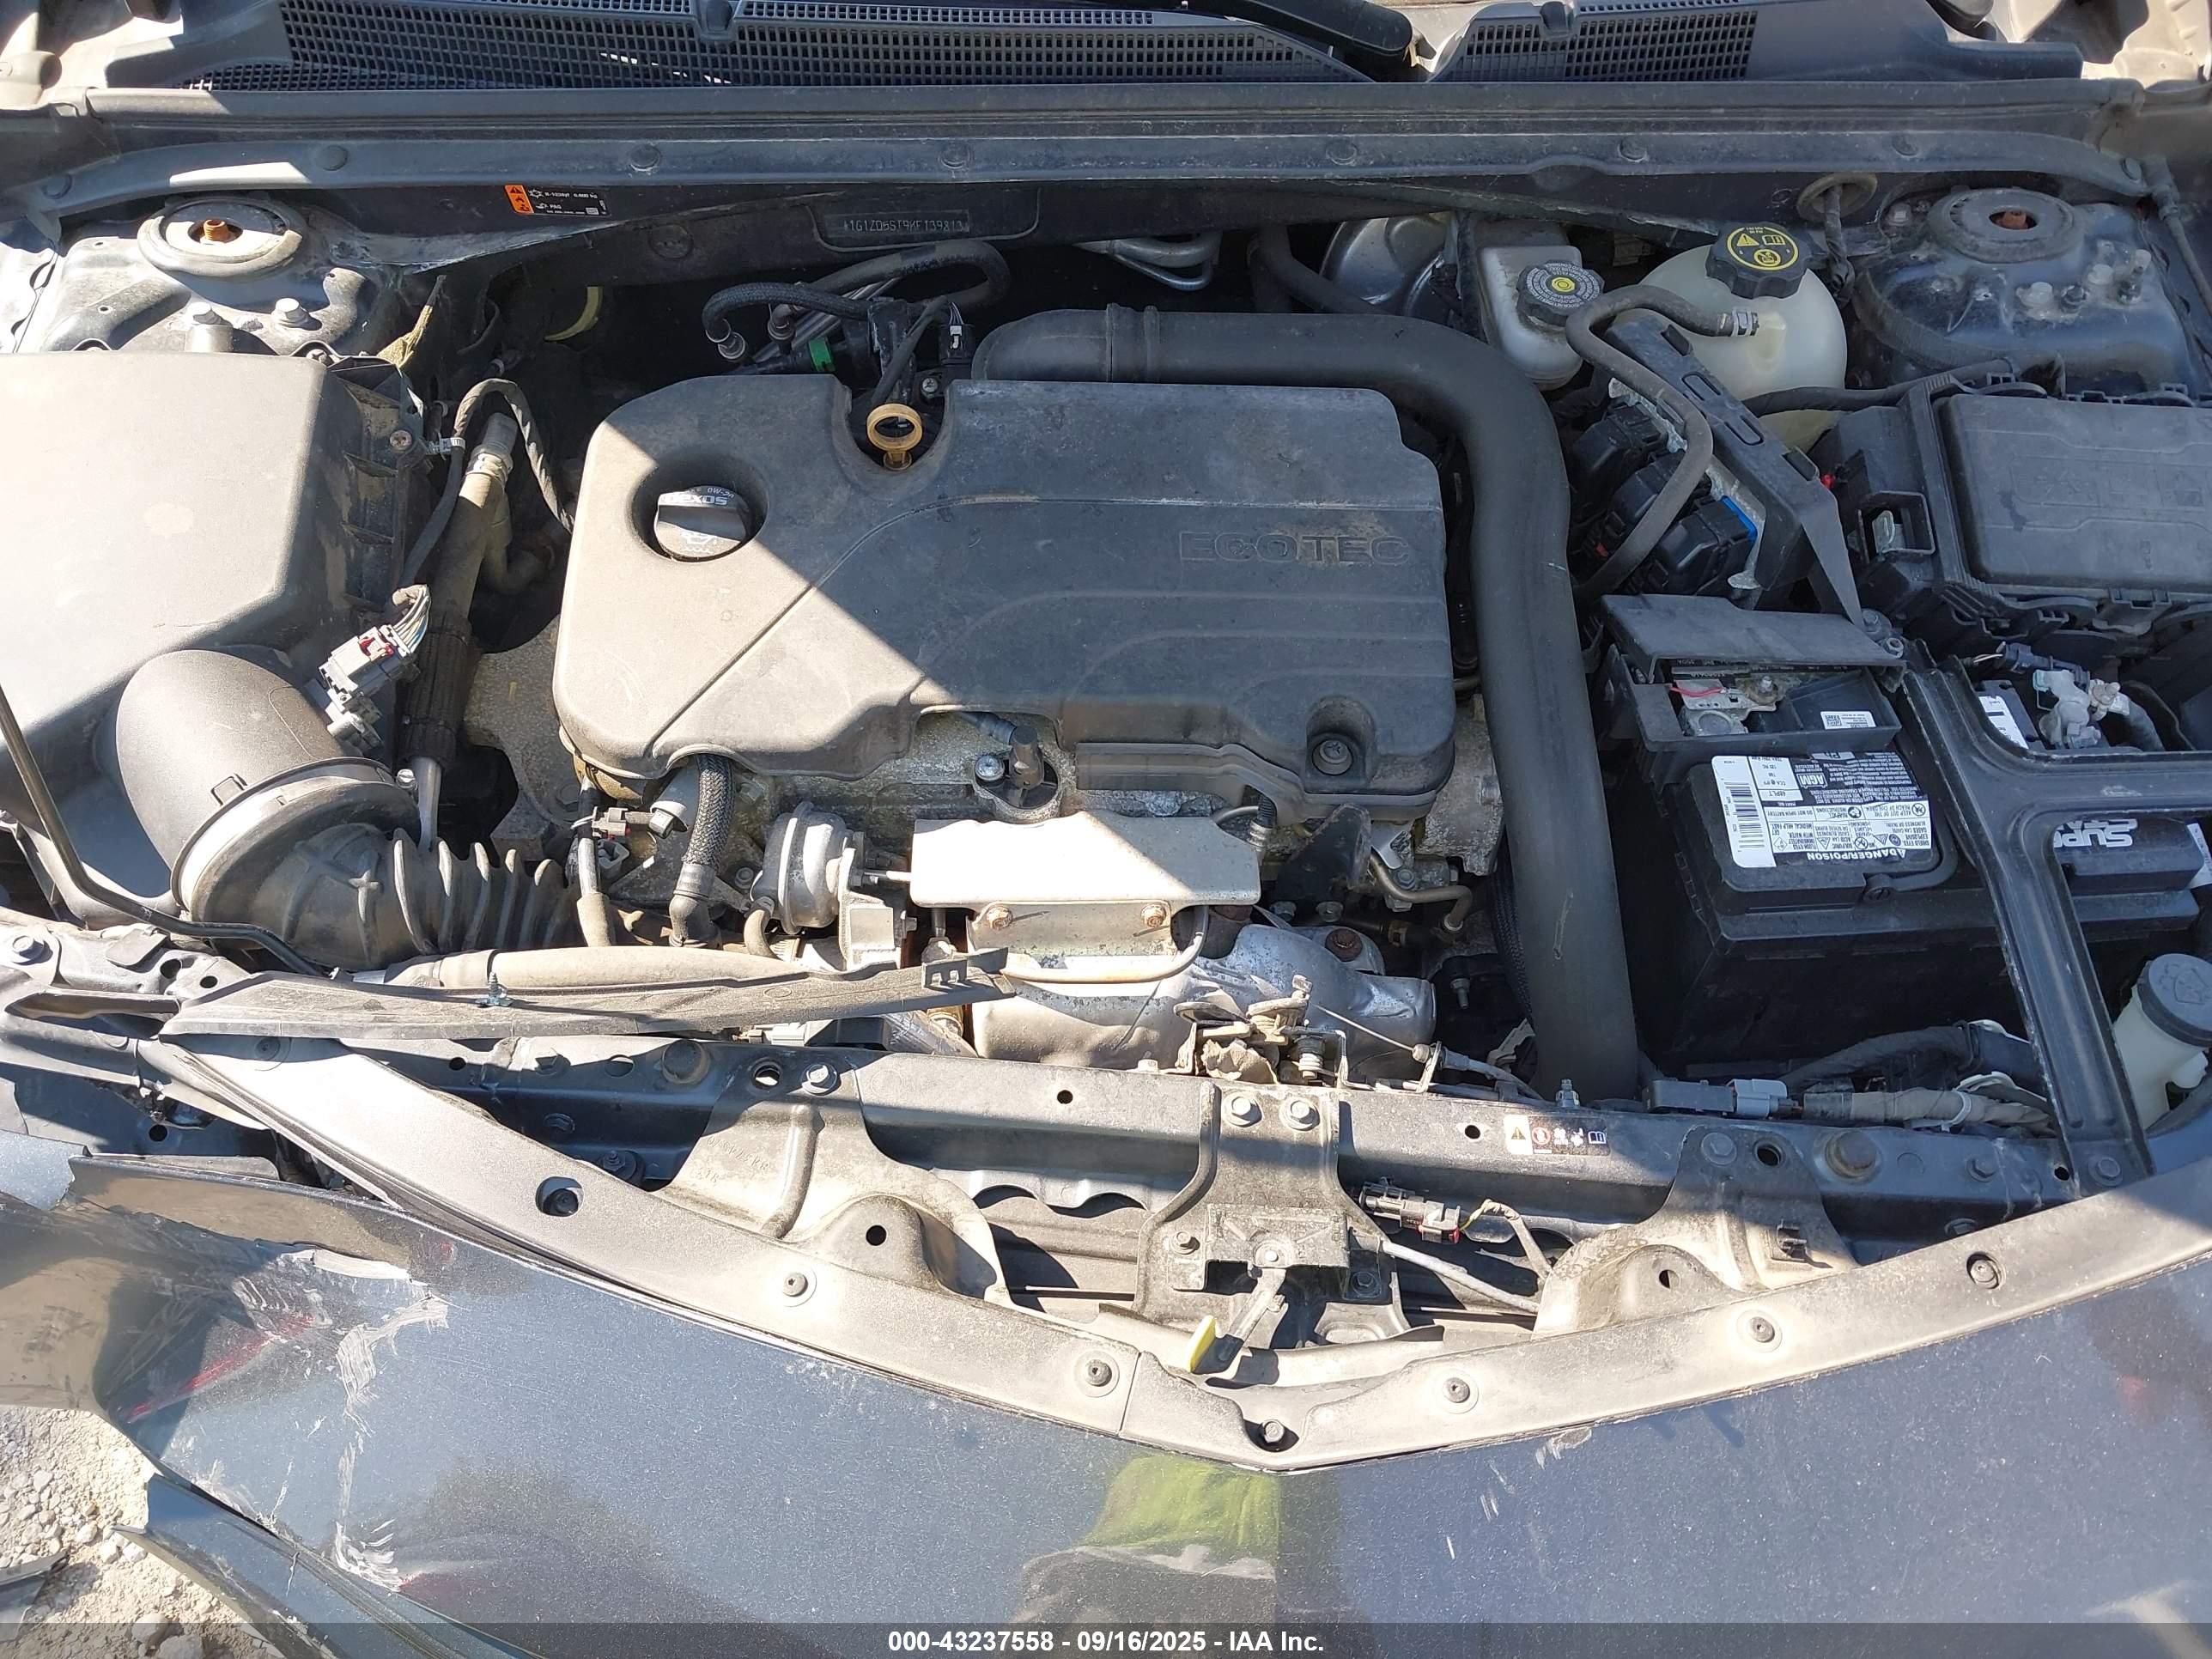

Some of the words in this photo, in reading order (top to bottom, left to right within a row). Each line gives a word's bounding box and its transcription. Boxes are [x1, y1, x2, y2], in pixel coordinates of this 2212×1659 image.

[1179, 531, 1409, 565] ECOTEC
[1799, 775, 1824, 785] AGM
[1807, 848, 1897, 860] DANGER/POISON
